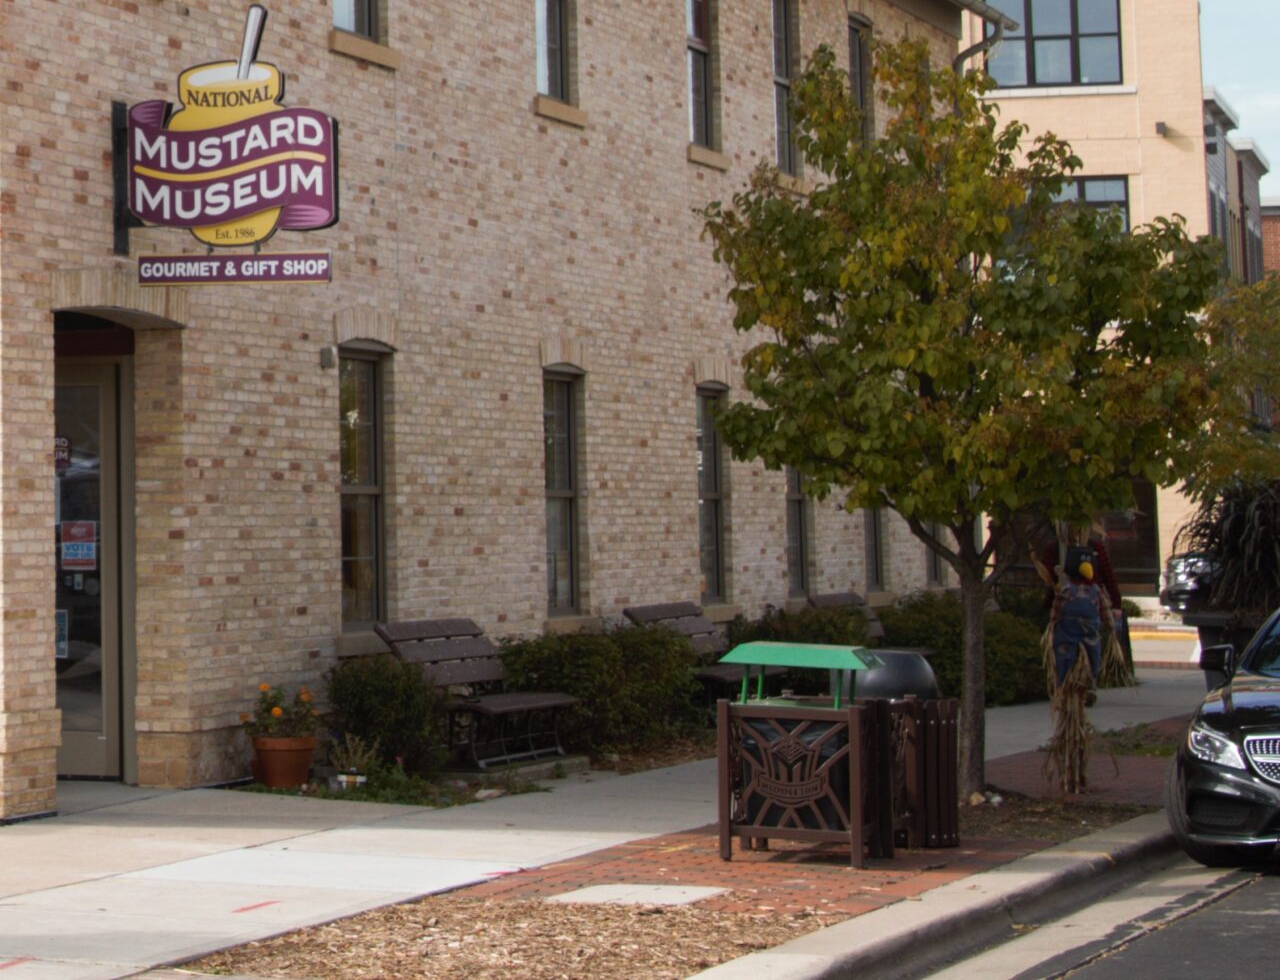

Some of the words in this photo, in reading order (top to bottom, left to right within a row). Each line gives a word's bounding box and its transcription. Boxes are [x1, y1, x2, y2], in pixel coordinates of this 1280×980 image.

[186, 85, 273, 109] NATIONAL
[134, 116, 323, 170] MUSTARD
[135, 163, 323, 220] MUSEUM
[215, 228, 232, 240] Est.
[234, 227, 255, 239] 1986
[140, 261, 220, 278] GOURMET
[224, 262, 237, 276] &
[241, 260, 279, 276] GIFT
[282, 259, 328, 275] SHOP
